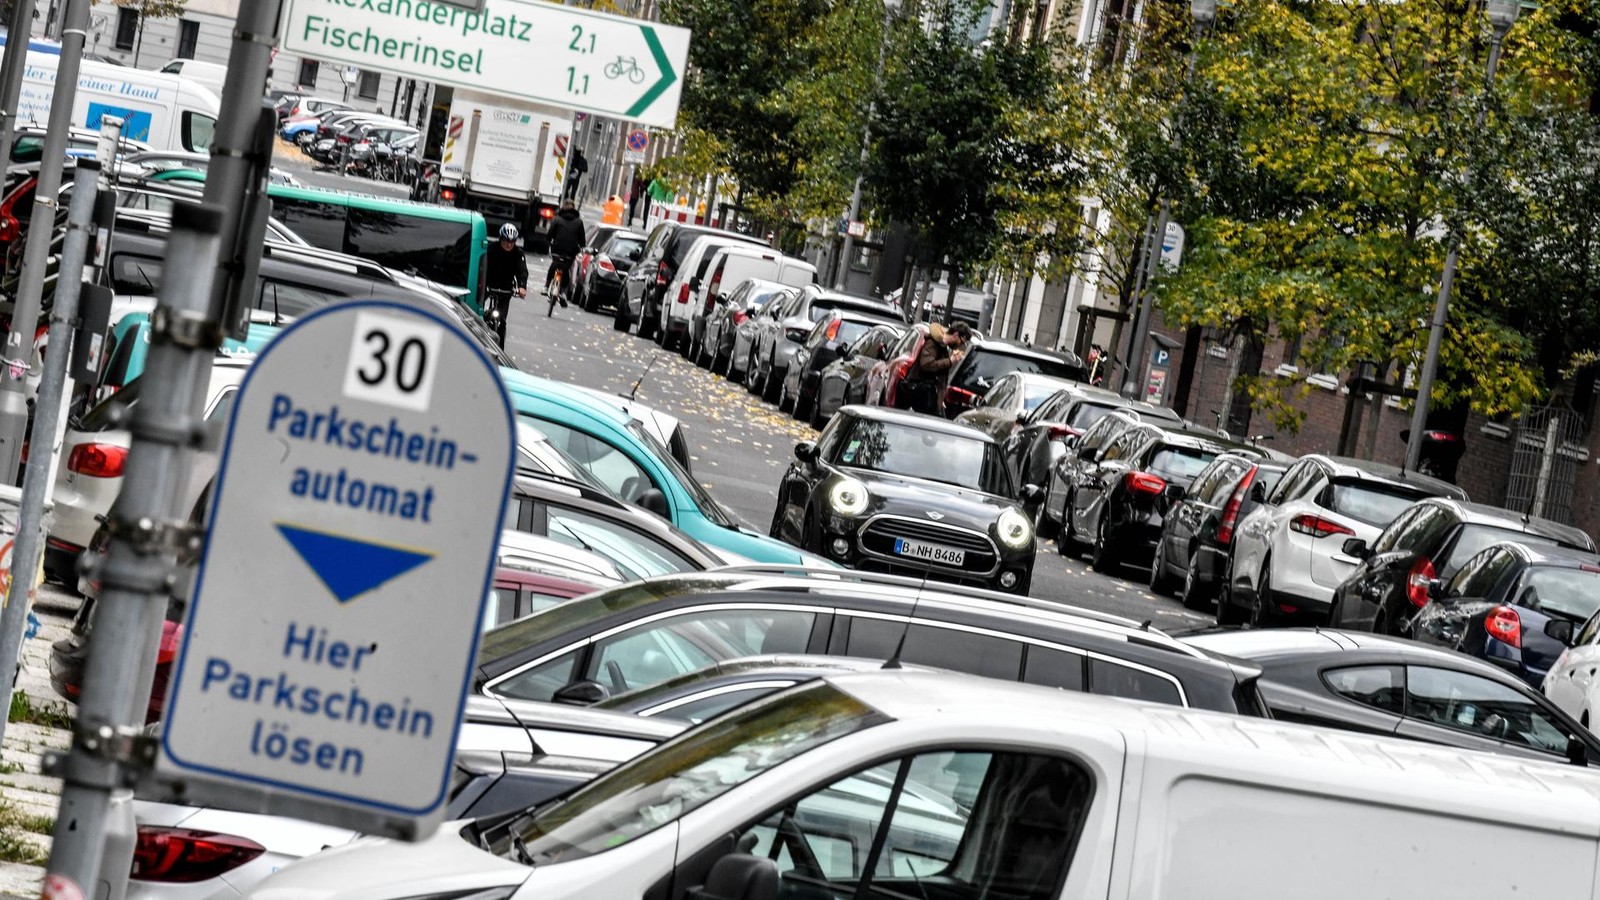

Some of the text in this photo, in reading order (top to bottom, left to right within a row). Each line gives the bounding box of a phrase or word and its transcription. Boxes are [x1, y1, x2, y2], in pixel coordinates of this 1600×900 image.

[303, 14, 590, 95] Fischerinsel 1,1
[326, 0, 597, 54] xanderplatz 2,1
[120, 80, 160, 100] Hand
[356, 329, 429, 394] 30
[266, 393, 479, 470] Parkschein-
[290, 468, 435, 523] automat
[901, 541, 962, 564] B NH 8486
[282, 622, 374, 672] Hier
[201, 657, 434, 739] Parkschein
[249, 719, 364, 775] lösen
